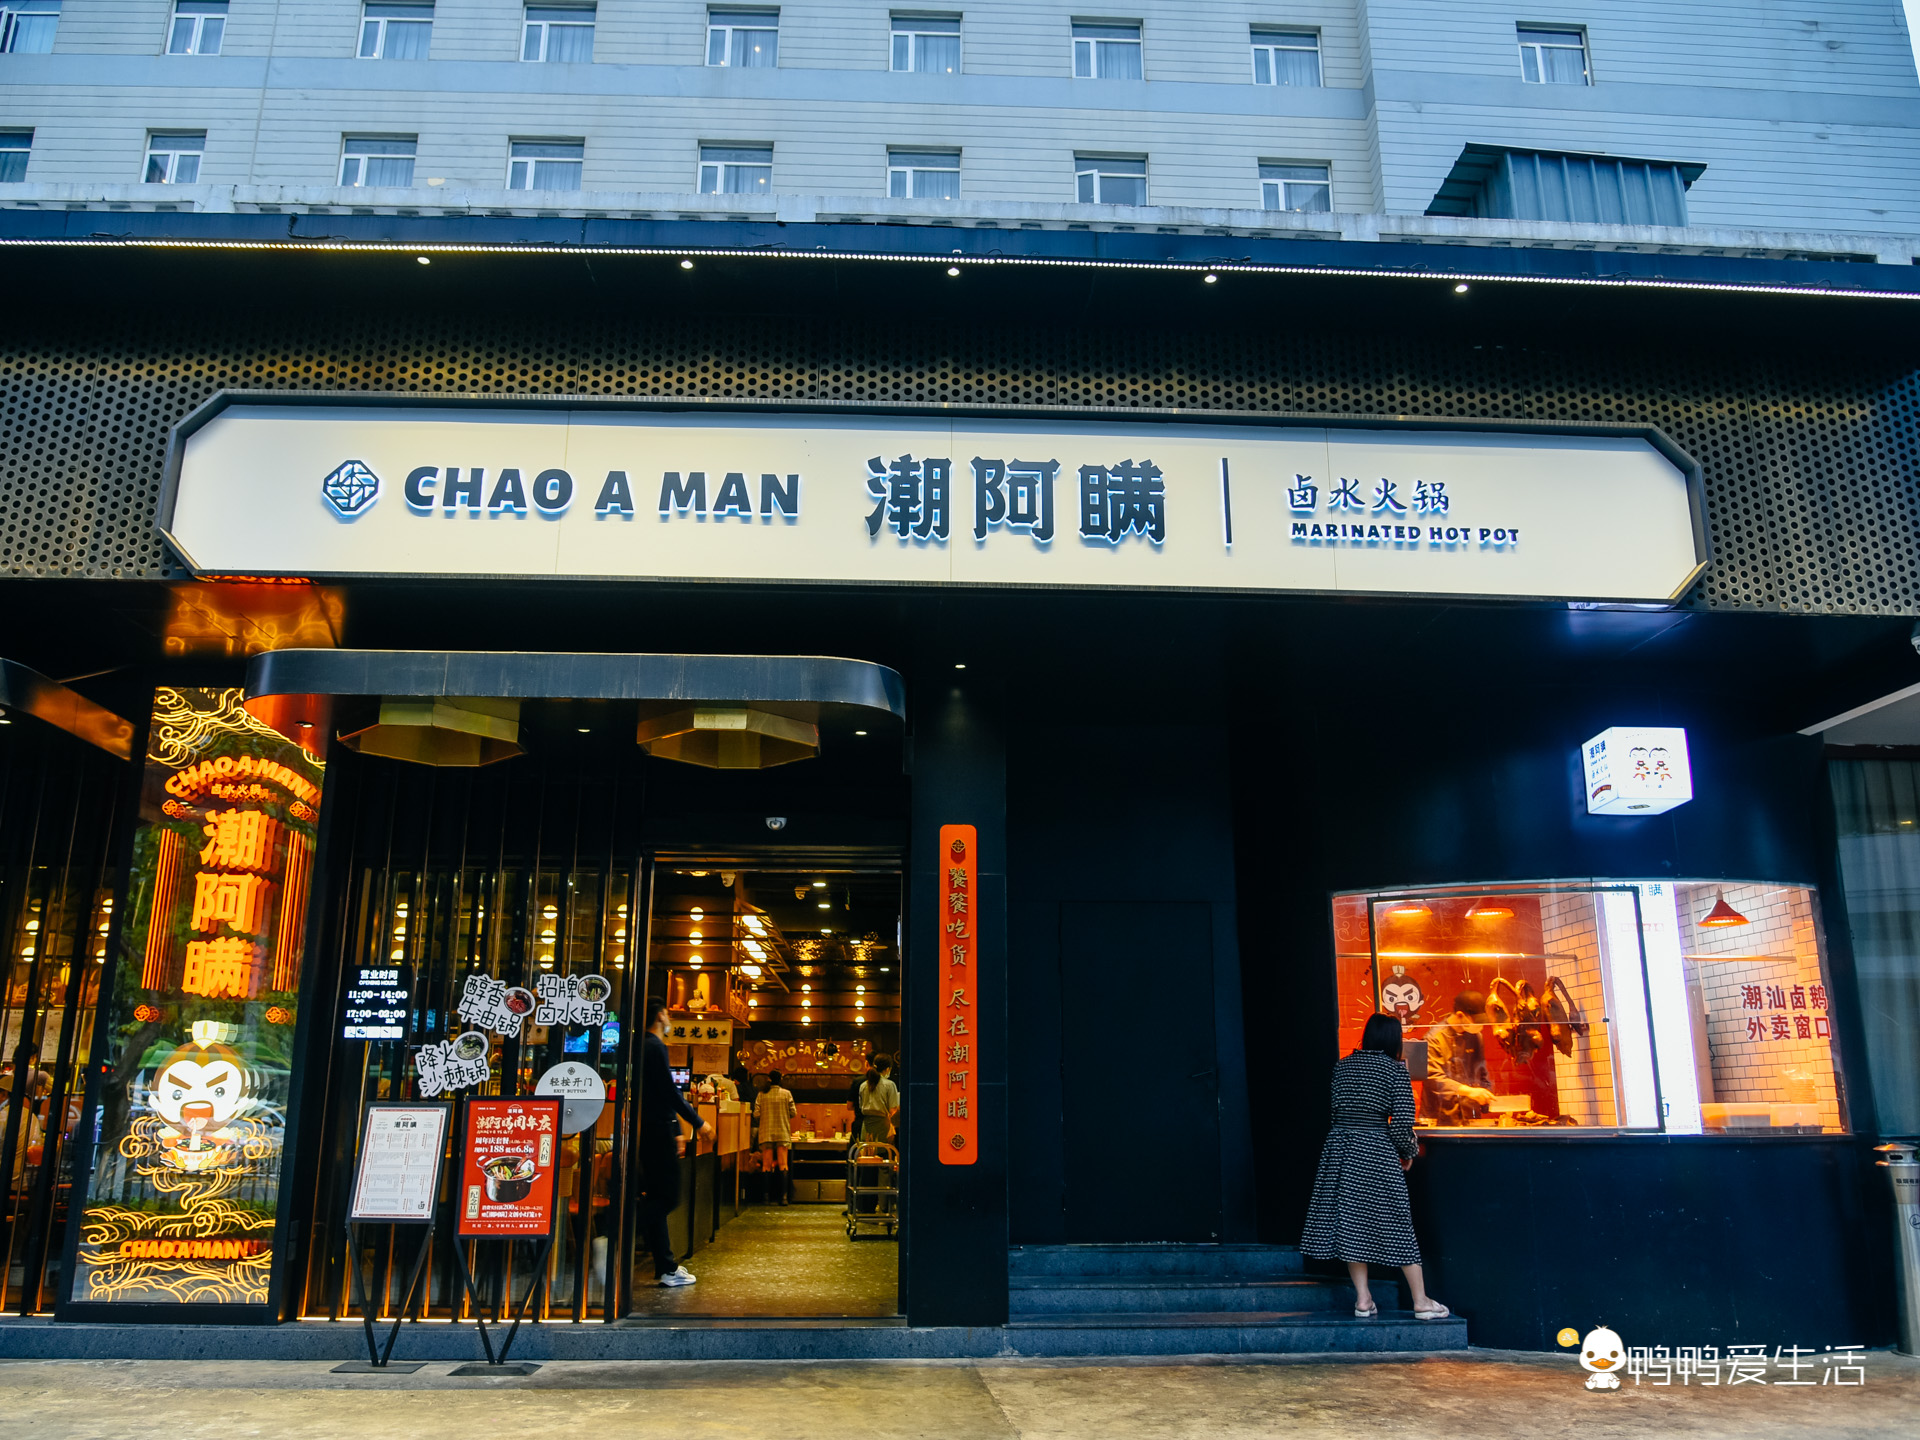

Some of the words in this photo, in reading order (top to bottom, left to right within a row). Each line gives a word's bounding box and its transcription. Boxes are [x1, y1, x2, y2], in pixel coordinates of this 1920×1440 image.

[404, 465, 574, 511] CHAO
[594, 470, 635, 514] A
[658, 471, 800, 517] MAN
[864, 453, 1166, 544] 潮阿瞒
[1287, 473, 1450, 513] 卤水火锅
[1291, 522, 1422, 541] MARINATED
[1429, 526, 1471, 543] HOT
[1479, 527, 1519, 545] POT
[165, 755, 233, 795] CHAO
[236, 755, 253, 773] A
[256, 757, 319, 802] MAN
[181, 807, 260, 998] 潮阿瞒
[360, 969, 398, 980] 营业时间
[538, 975, 578, 1001] 招牌
[465, 975, 506, 1008] 醇香
[1740, 984, 1828, 1011] 潮汕卤鹅
[459, 996, 523, 1036] 牛油锅
[537, 1001, 604, 1025] 卤水锅
[1746, 1013, 1832, 1042] 外卖窗口
[663, 1026, 719, 1040] 迎光临
[418, 1042, 459, 1071] 降火
[760, 1046, 797, 1068] CHAO
[420, 1058, 488, 1095] 沙棘锅
[549, 1076, 593, 1088] 轻按开门
[119, 1240, 175, 1259] CHAO
[193, 1241, 241, 1260] MAN
